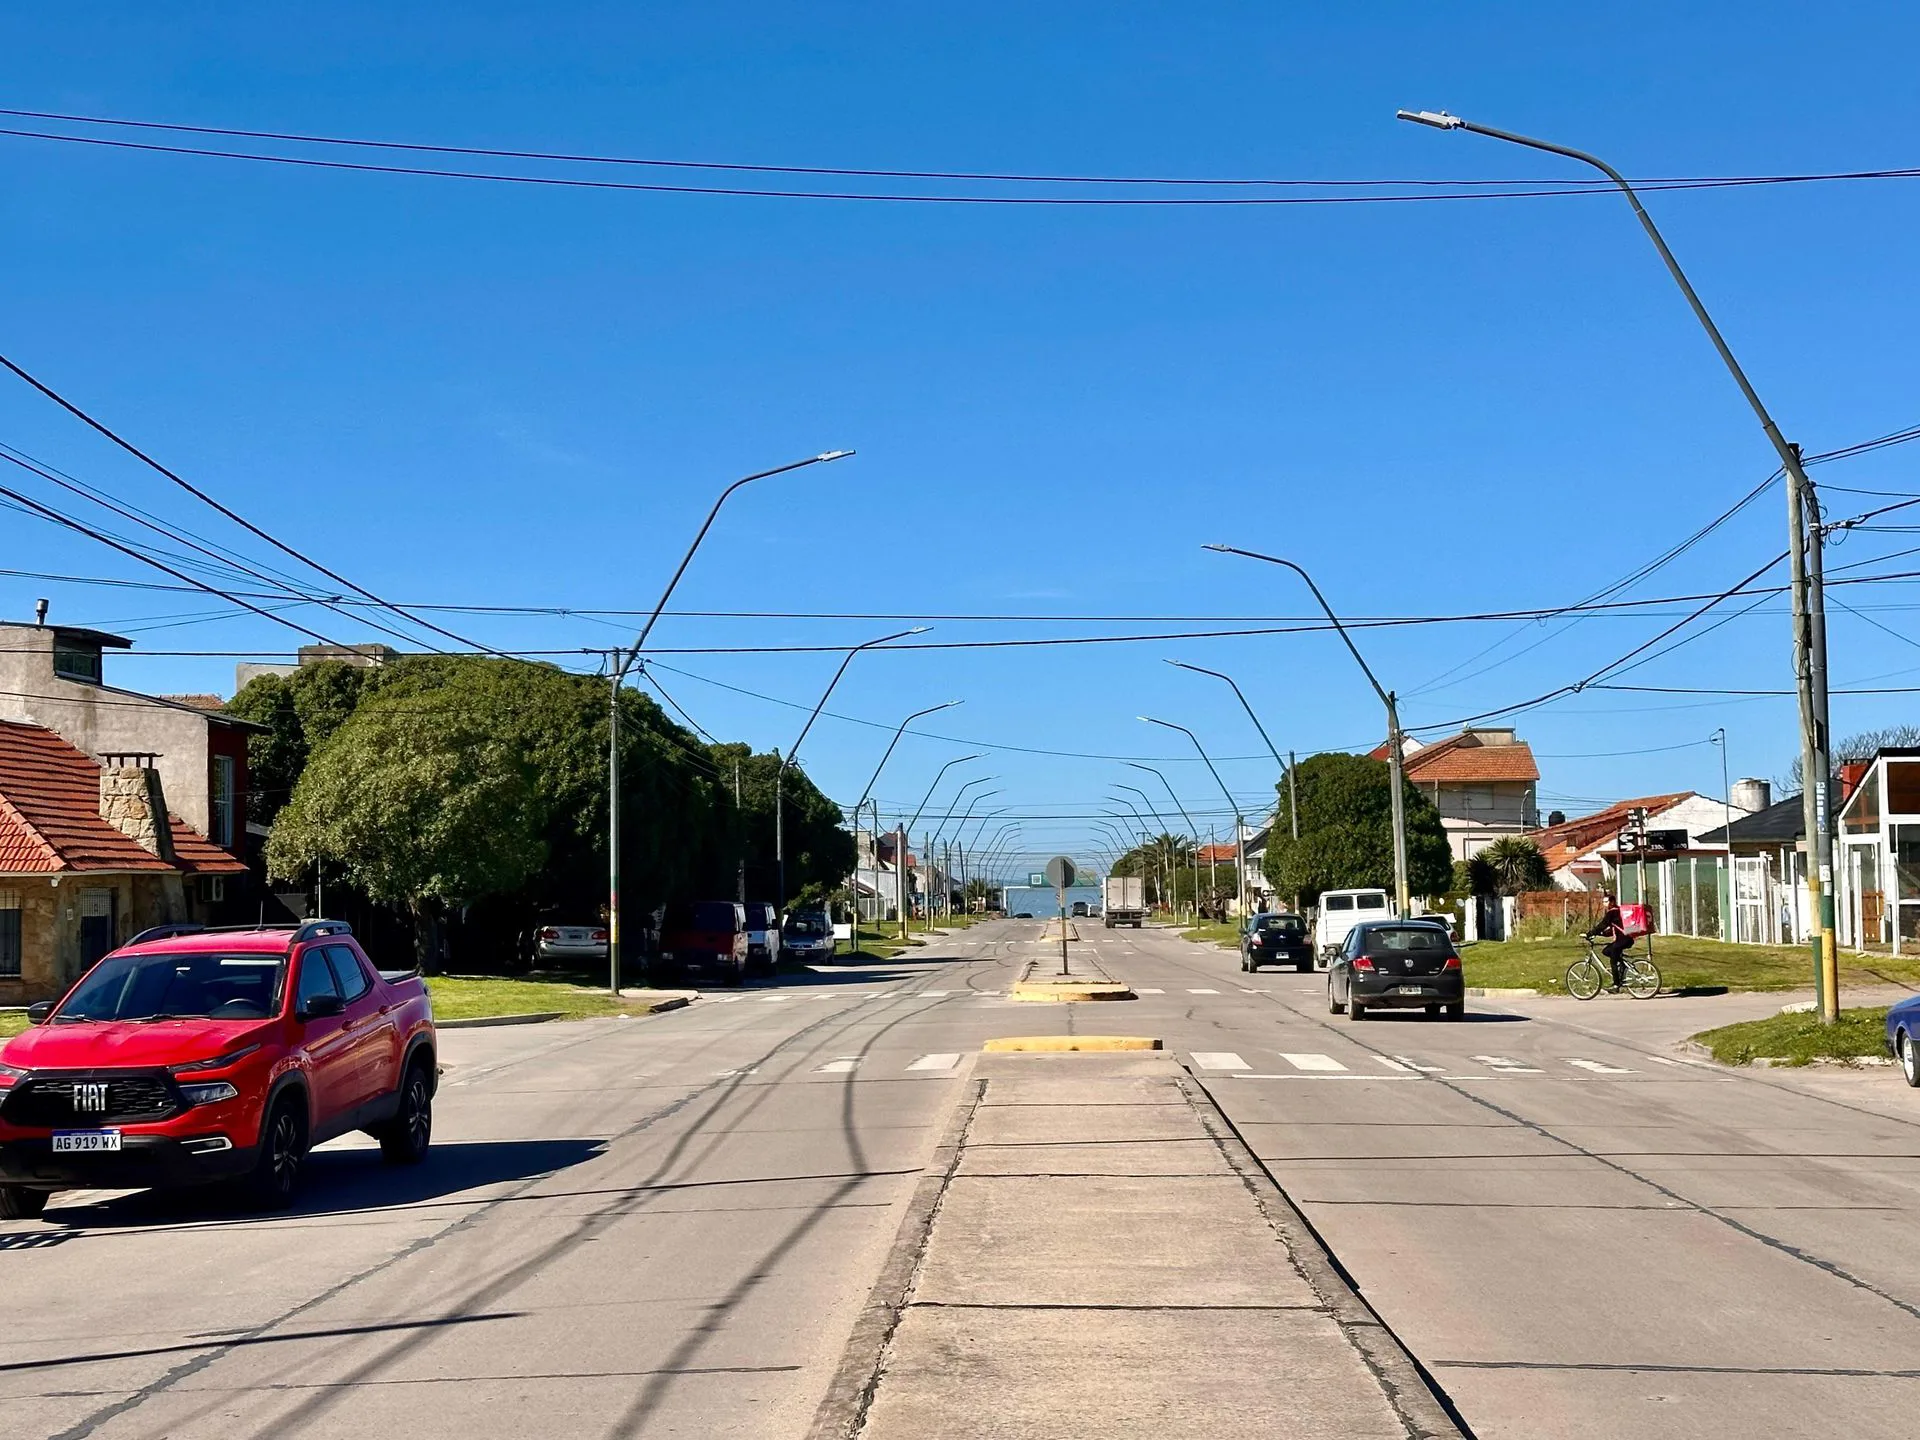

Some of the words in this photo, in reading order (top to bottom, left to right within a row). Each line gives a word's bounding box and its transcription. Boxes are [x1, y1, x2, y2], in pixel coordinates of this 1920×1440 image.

[73, 1084, 109, 1111] FIAT
[56, 1137, 71, 1150] AG
[75, 1136, 98, 1150] 919
[102, 1136, 117, 1149] WX
